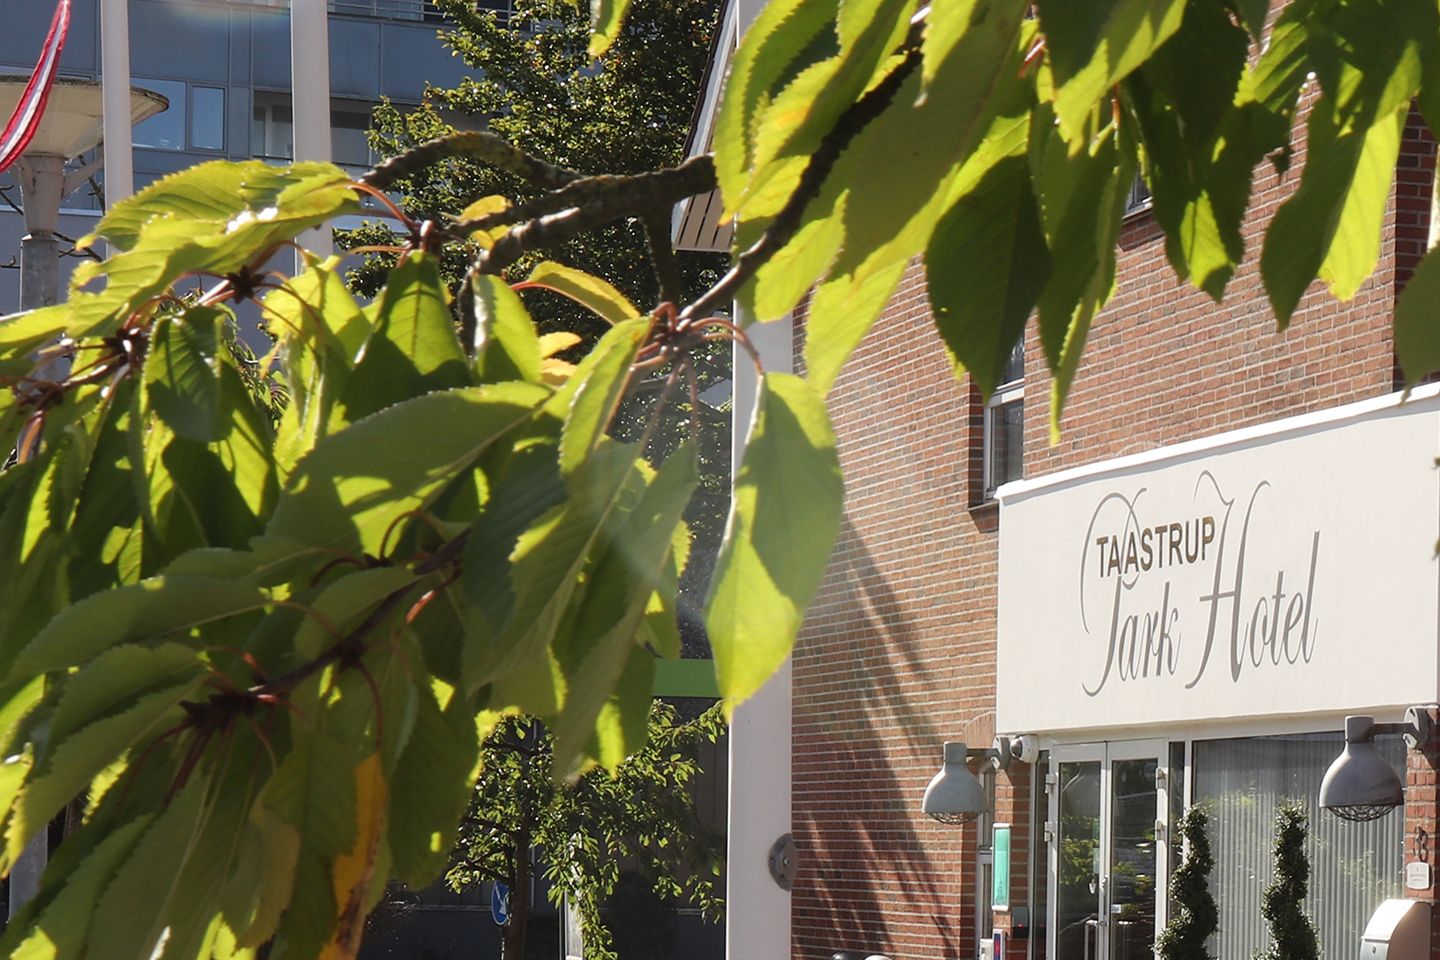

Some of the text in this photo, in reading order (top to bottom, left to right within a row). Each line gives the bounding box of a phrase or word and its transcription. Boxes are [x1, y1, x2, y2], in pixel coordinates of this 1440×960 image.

[1080, 470, 1320, 697] Park Hotel
[1096, 515, 1216, 578] TAASTRUP
